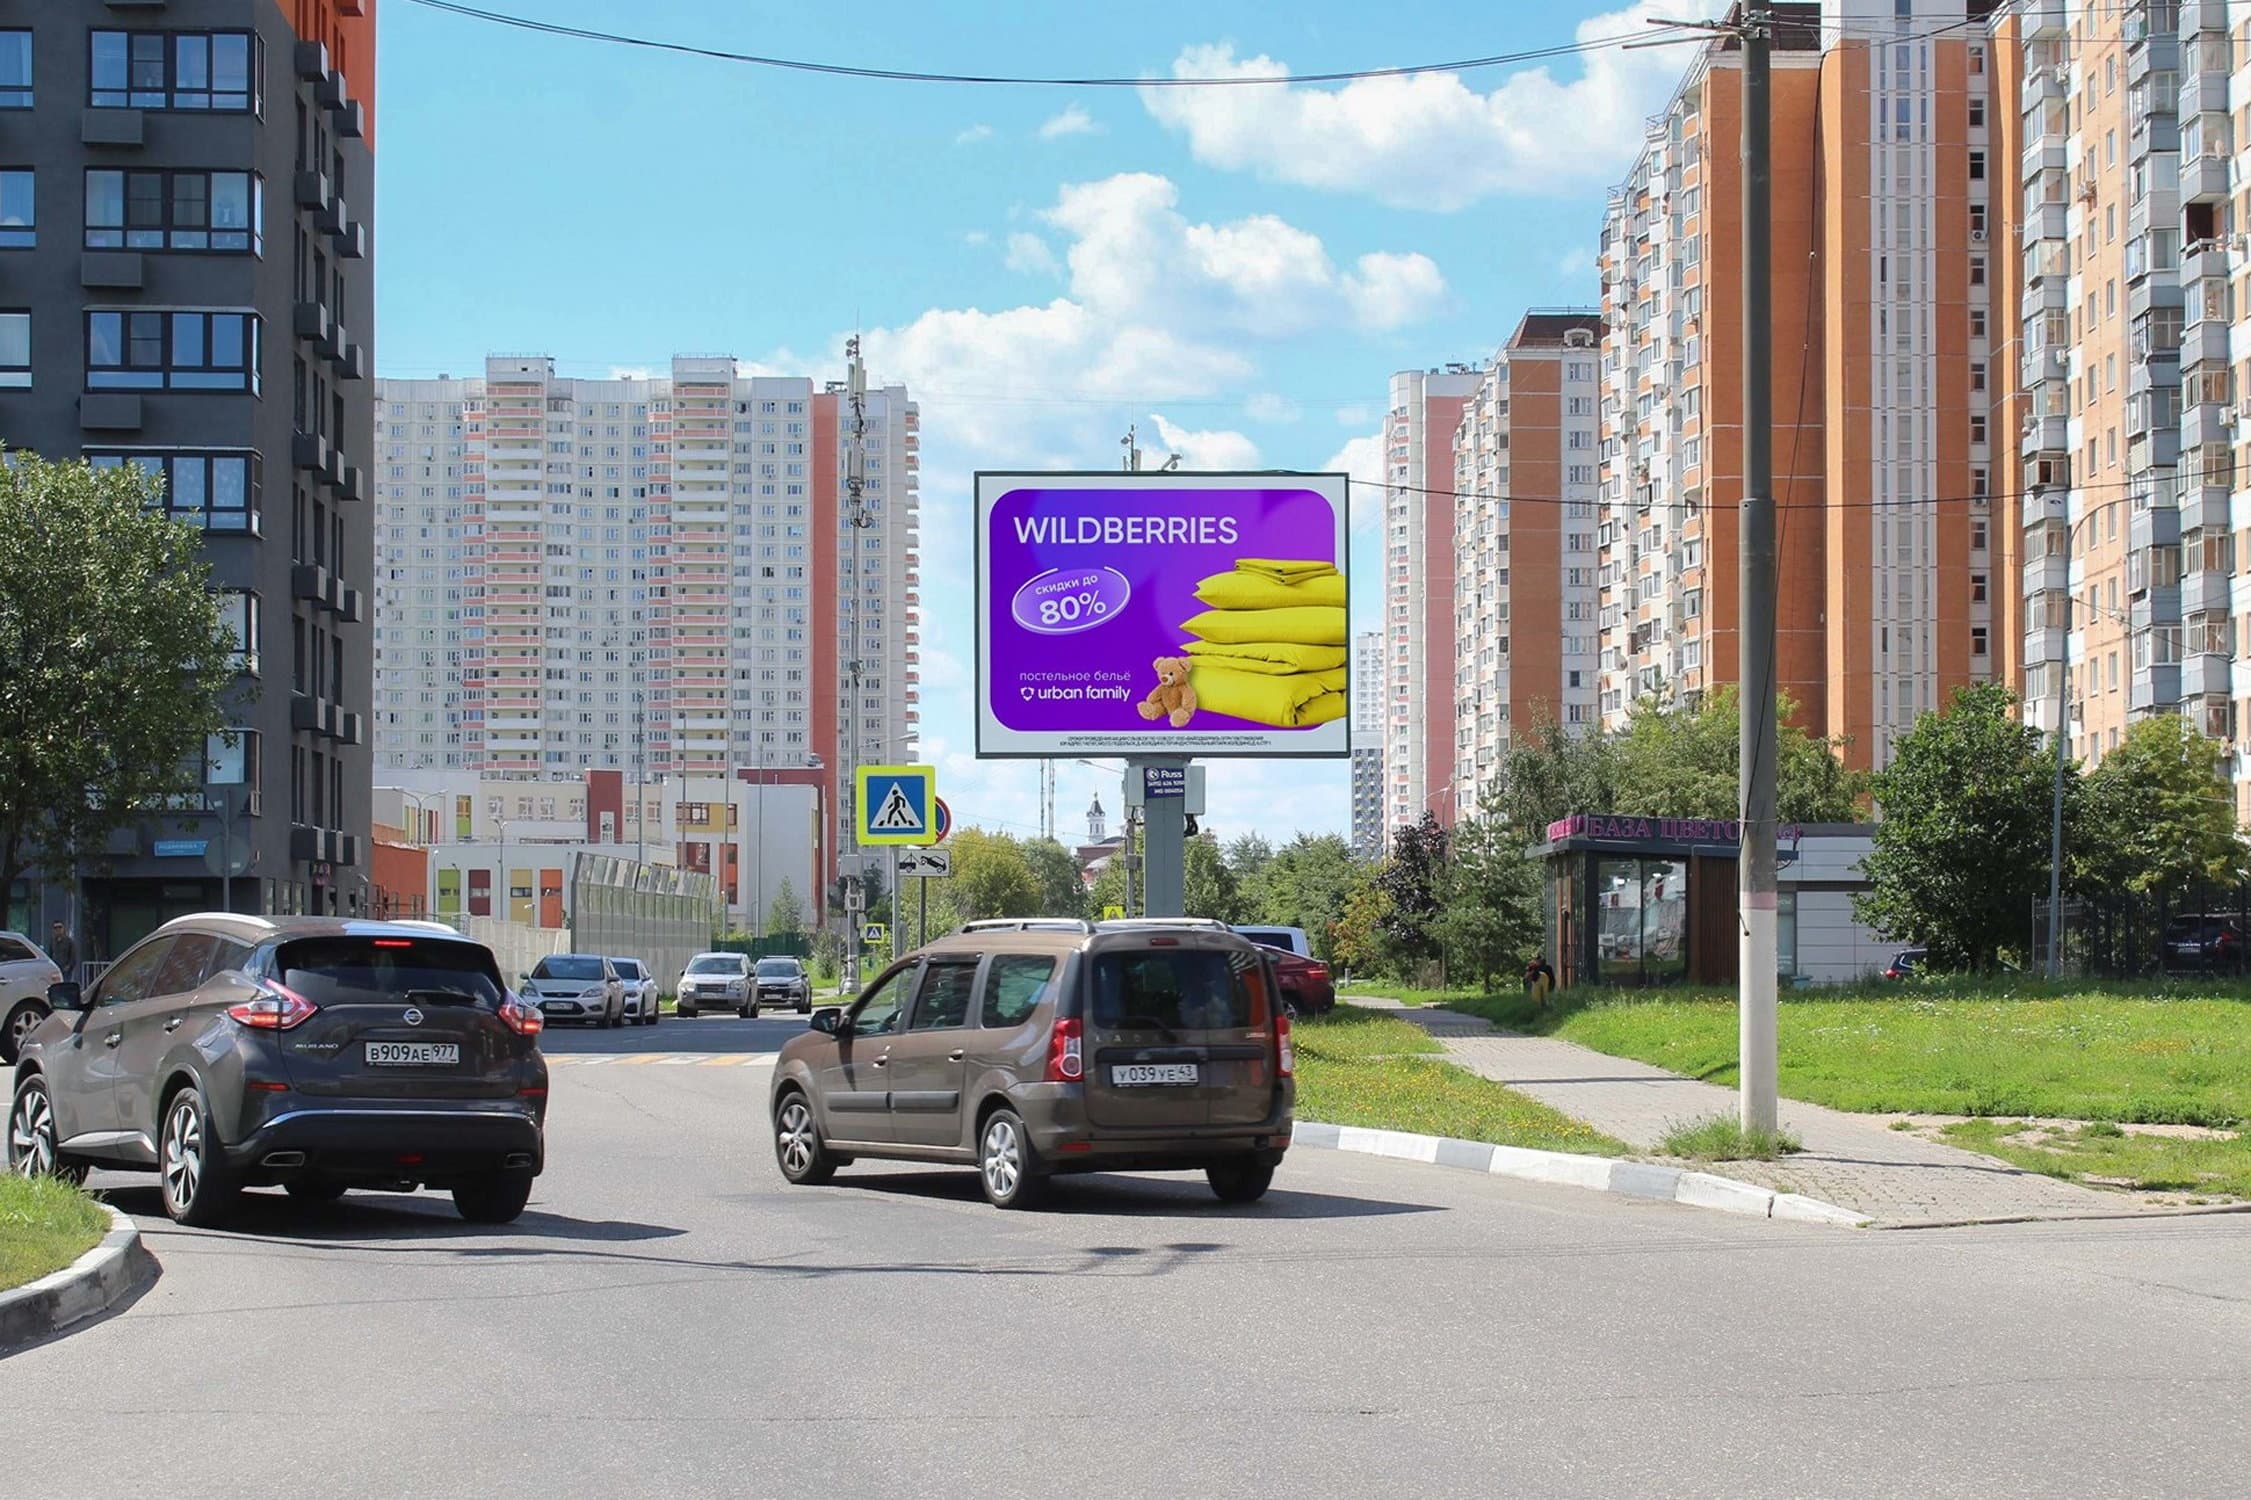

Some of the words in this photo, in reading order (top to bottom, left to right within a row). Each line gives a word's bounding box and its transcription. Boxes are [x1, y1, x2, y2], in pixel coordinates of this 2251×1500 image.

[1013, 516, 1238, 544] WILDBERRIES
[1035, 579, 1079, 595] скидки
[1082, 575, 1098, 586] до
[1039, 590, 1106, 624] 80%
[1019, 672, 1090, 681] постельное
[1093, 670, 1131, 681] бельё
[1038, 685, 1083, 700] urban
[1086, 685, 1131, 702] family
[1160, 770, 1183, 778] Russ
[1588, 817, 1653, 838] БАЗА
[1660, 819, 1740, 841] ЦВЕТО
[433, 1044, 455, 1057] 977
[1178, 1065, 1193, 1077] 43
